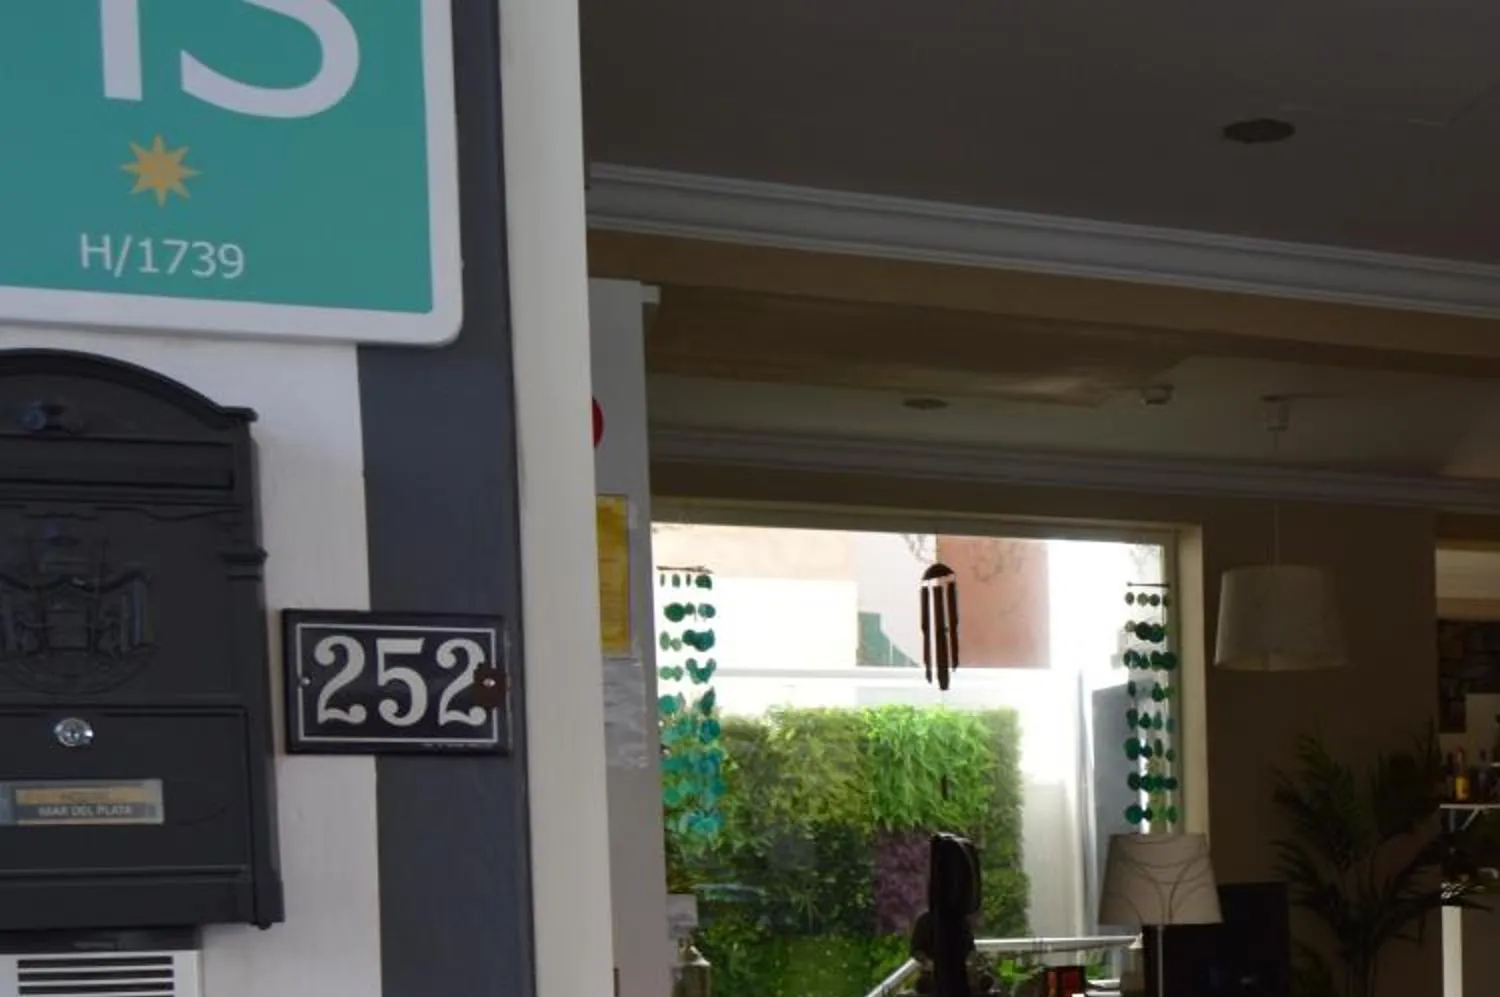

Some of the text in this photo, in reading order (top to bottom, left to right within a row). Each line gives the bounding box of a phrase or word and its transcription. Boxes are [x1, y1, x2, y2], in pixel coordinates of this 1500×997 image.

[80, 233, 246, 279] H/1739
[314, 635, 489, 728] 252
[38, 804, 133, 817] MAR DEL PLATA
